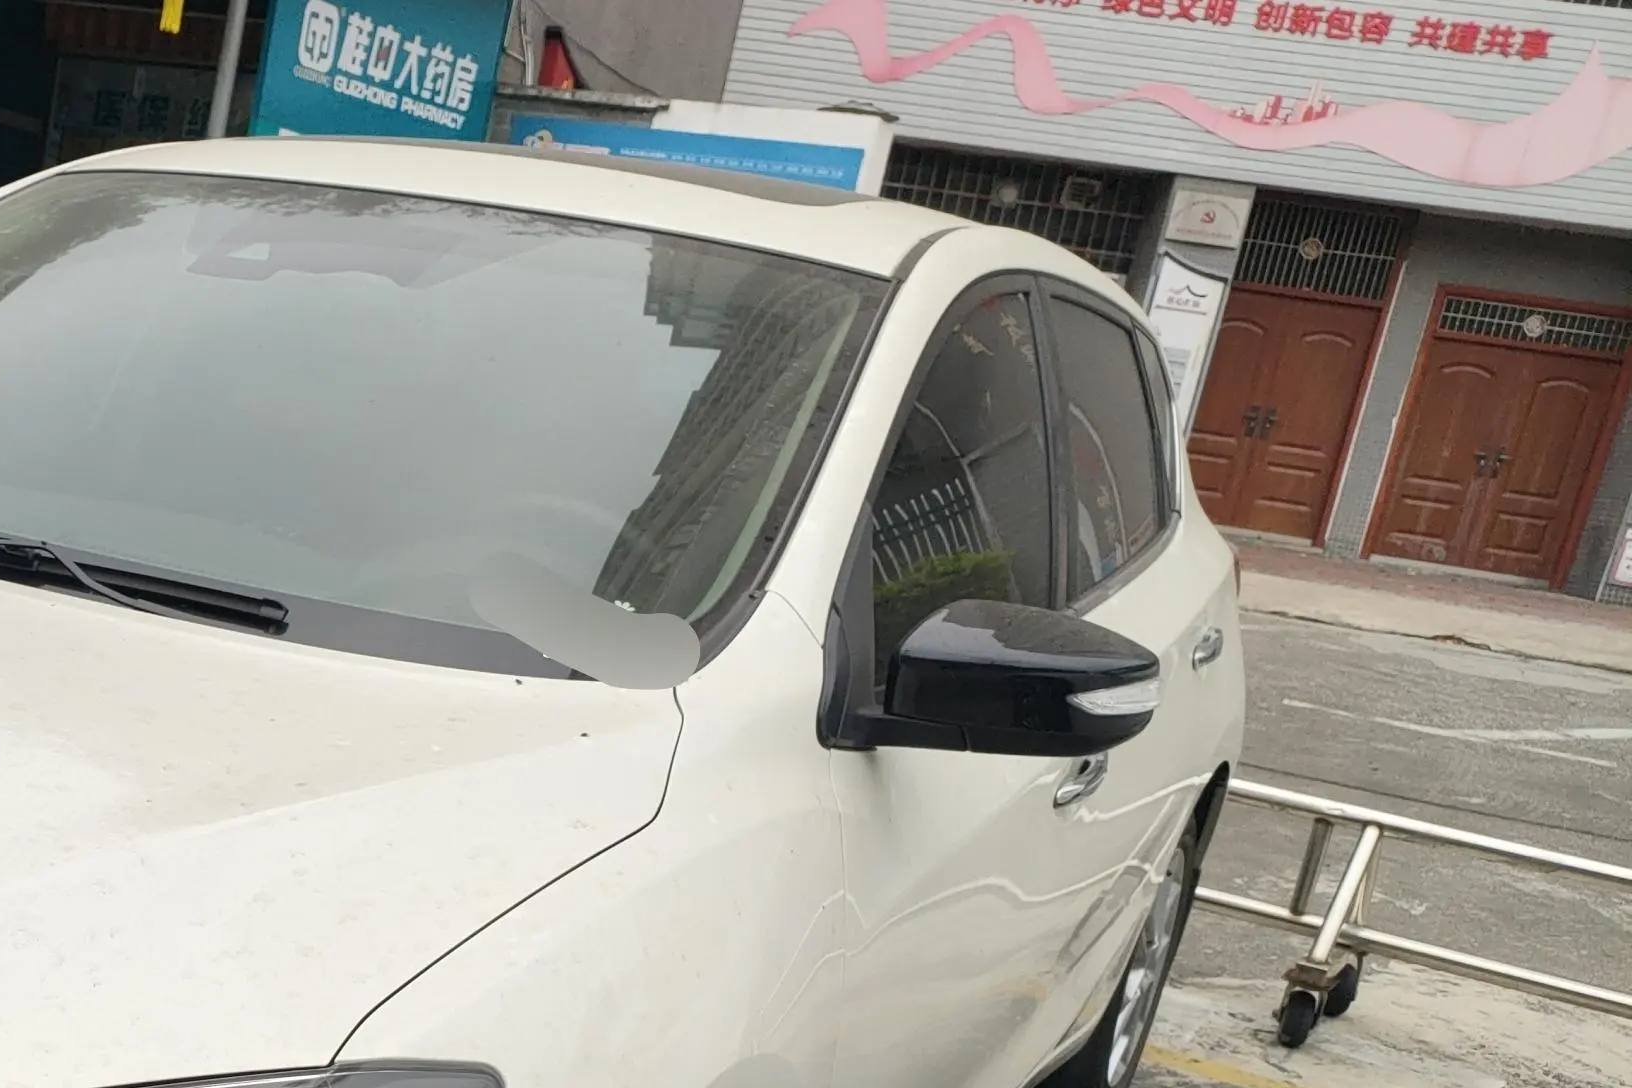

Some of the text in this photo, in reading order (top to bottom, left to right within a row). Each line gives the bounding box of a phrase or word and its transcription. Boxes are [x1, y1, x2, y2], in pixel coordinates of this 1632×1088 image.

[337, 11, 479, 111] 桂中大药房
[1253, 1, 1394, 45] 创新包容
[1408, 16, 1553, 61] 共建共享
[333, 75, 467, 130] GUIZHONG PHARMACY
